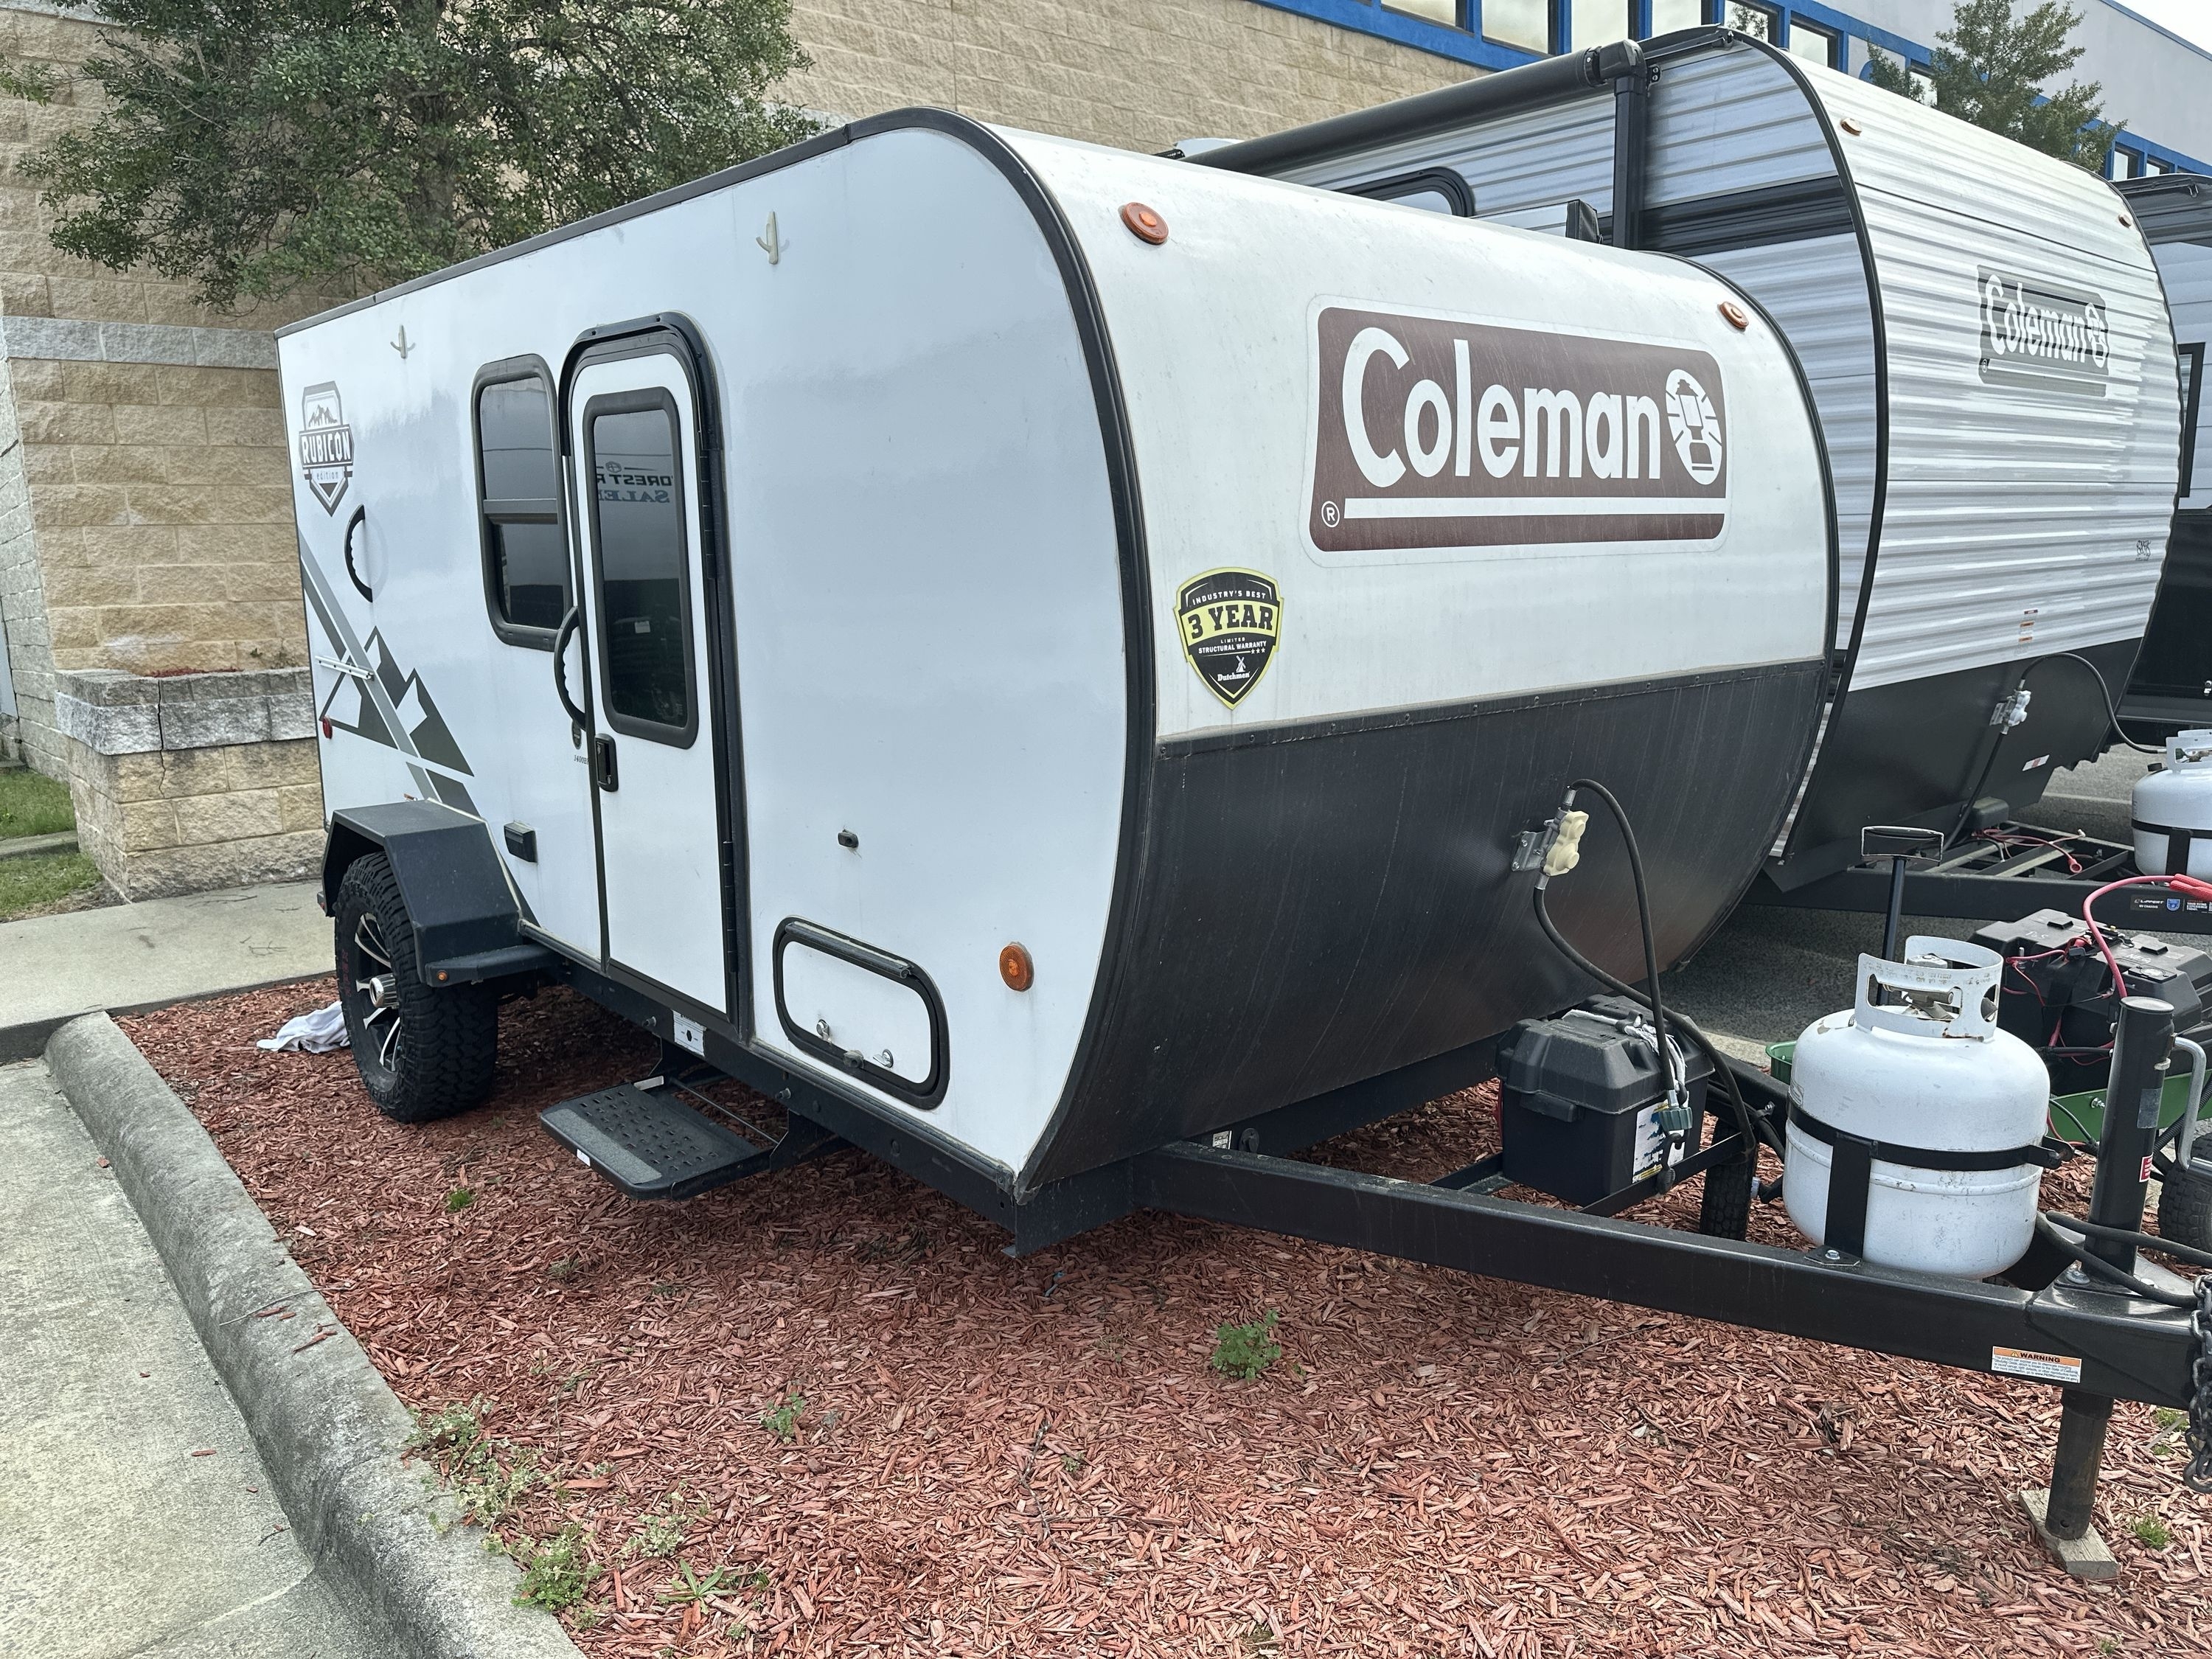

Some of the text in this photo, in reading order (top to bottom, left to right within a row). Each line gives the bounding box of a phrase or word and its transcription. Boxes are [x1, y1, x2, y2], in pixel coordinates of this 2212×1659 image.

[1985, 274, 2087, 363] Coleman
[1342, 327, 1661, 488] Coleman
[301, 431, 351, 464] RUBICON
[316, 470, 338, 480] edition
[1192, 590, 1266, 605] INDUSTRY'S BEST
[1187, 604, 1273, 639] 3 YEAR
[1198, 640, 1267, 654] STRUCTURAL WARRANTY
[2020, 1352, 2061, 1363] WARNING
